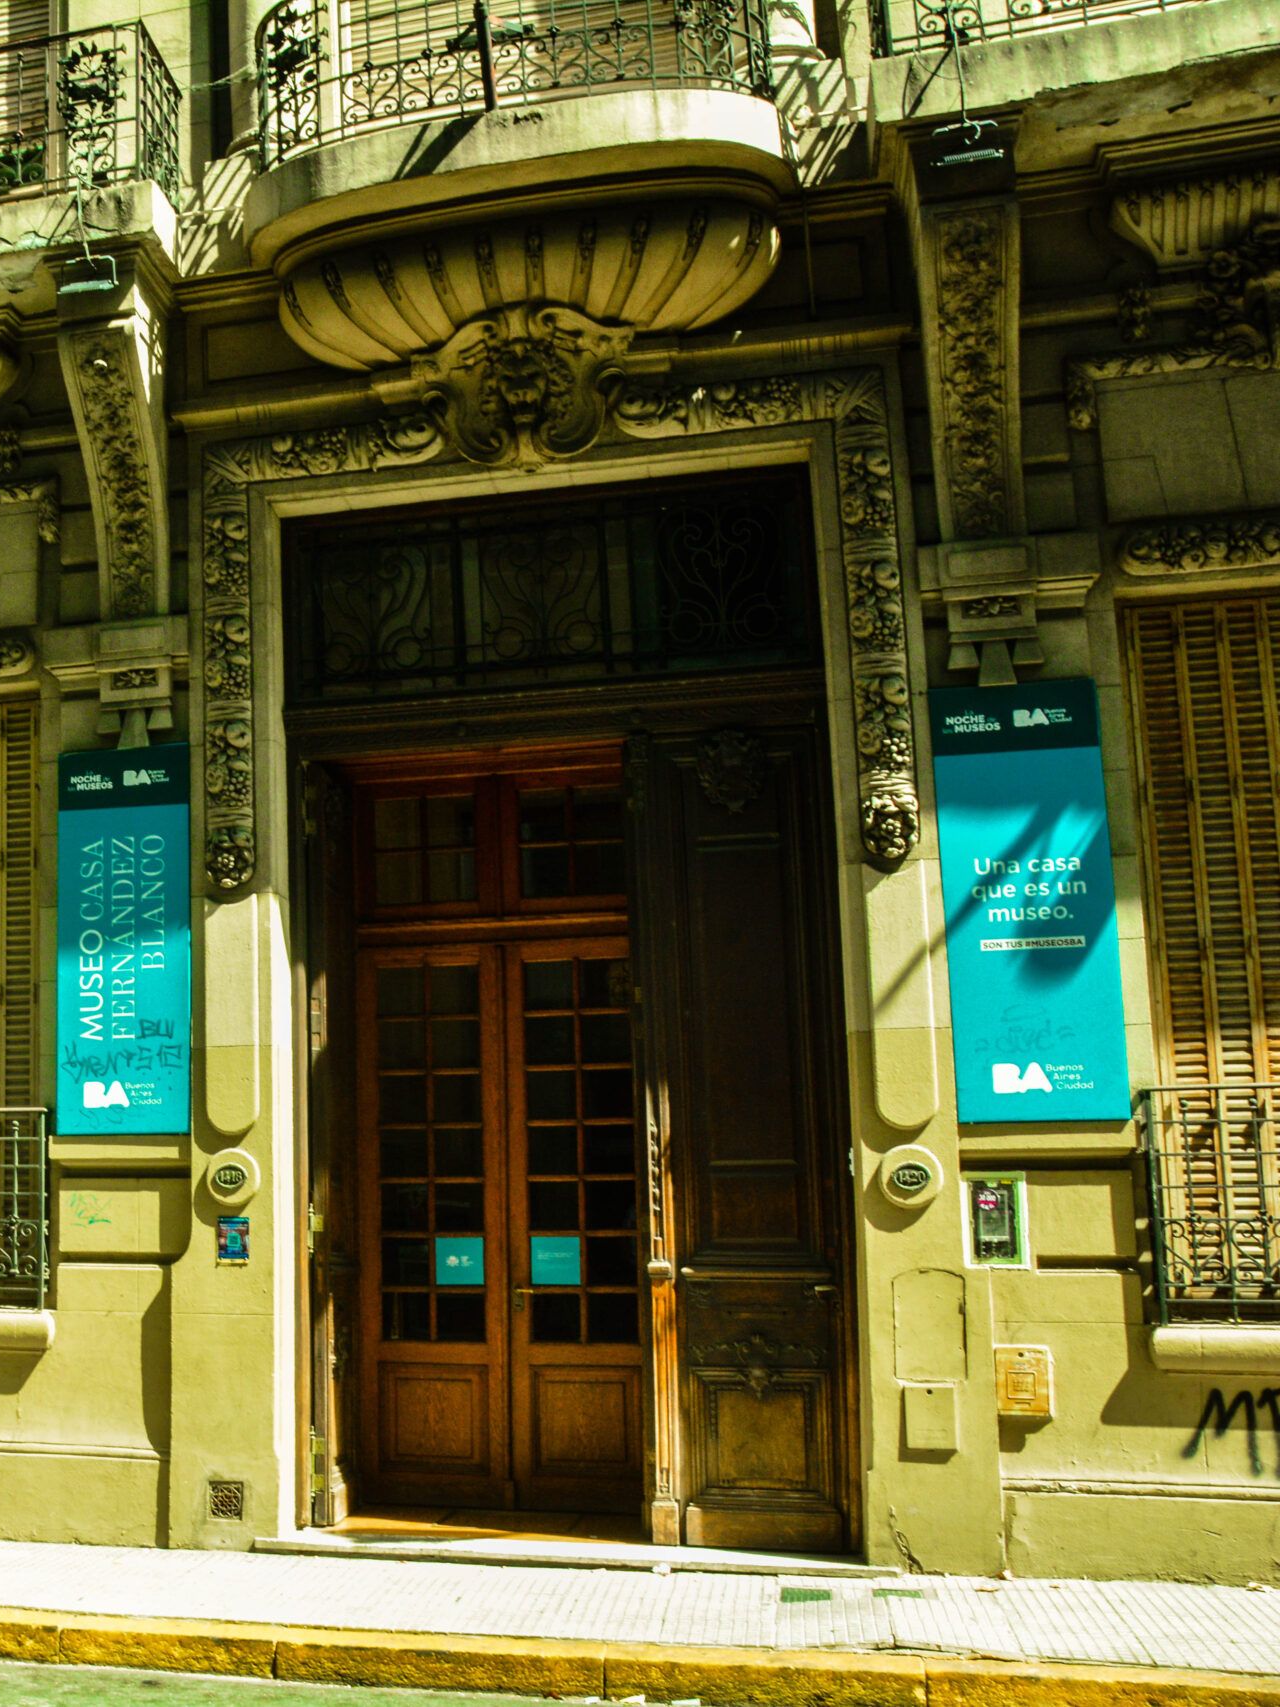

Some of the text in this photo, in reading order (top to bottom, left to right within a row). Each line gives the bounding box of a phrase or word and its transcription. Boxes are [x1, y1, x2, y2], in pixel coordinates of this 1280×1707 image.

[946, 715, 985, 725] NOCHE
[1013, 708, 1049, 727] BA
[954, 722, 1001, 733] MUSEOS
[70, 774, 102, 784] NOCHE
[123, 769, 151, 786] BA
[76, 781, 114, 791] MUSEOS
[973, 857, 1081, 875] Una casa
[972, 880, 1087, 902] que es un
[140, 834, 165, 970] BLANCO
[988, 906, 1074, 922] museo.
[79, 837, 104, 1041] MUSEO CASA
[104, 836, 135, 1041] FERNÁNDEZ
[983, 938, 1083, 950] SON TUS #MUSEOSBA
[1045, 1063, 1084, 1072] Buenos
[992, 1061, 1053, 1094] BA
[1053, 1072, 1081, 1080] Aires
[1056, 1081, 1094, 1089] Ciudad
[83, 1080, 130, 1109] BA
